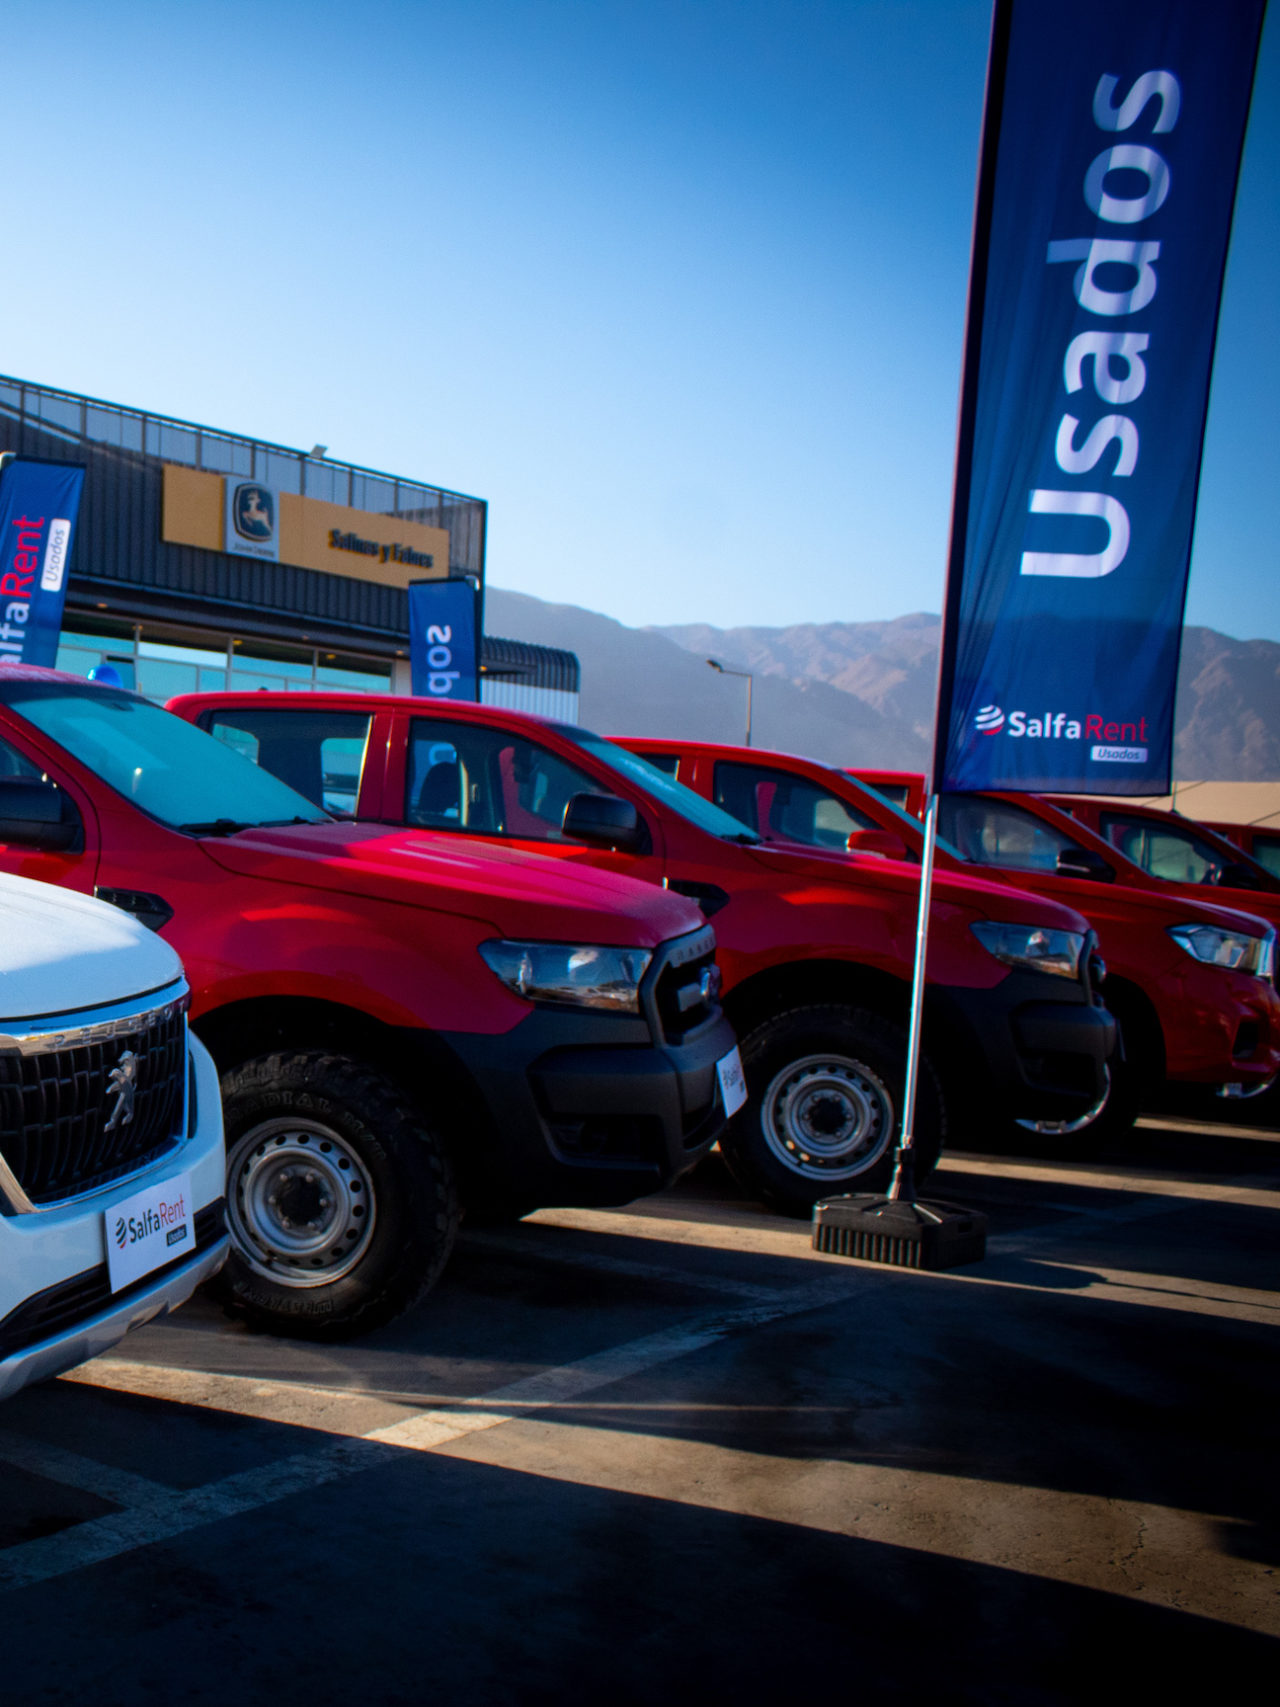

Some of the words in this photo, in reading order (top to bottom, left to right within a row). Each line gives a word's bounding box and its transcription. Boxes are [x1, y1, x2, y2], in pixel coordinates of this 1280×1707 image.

[1020, 70, 1181, 578] Usados
[44, 529, 65, 582] Usados
[1008, 711, 1148, 742] SalfaRent
[128, 1193, 186, 1243] SalfaRent
